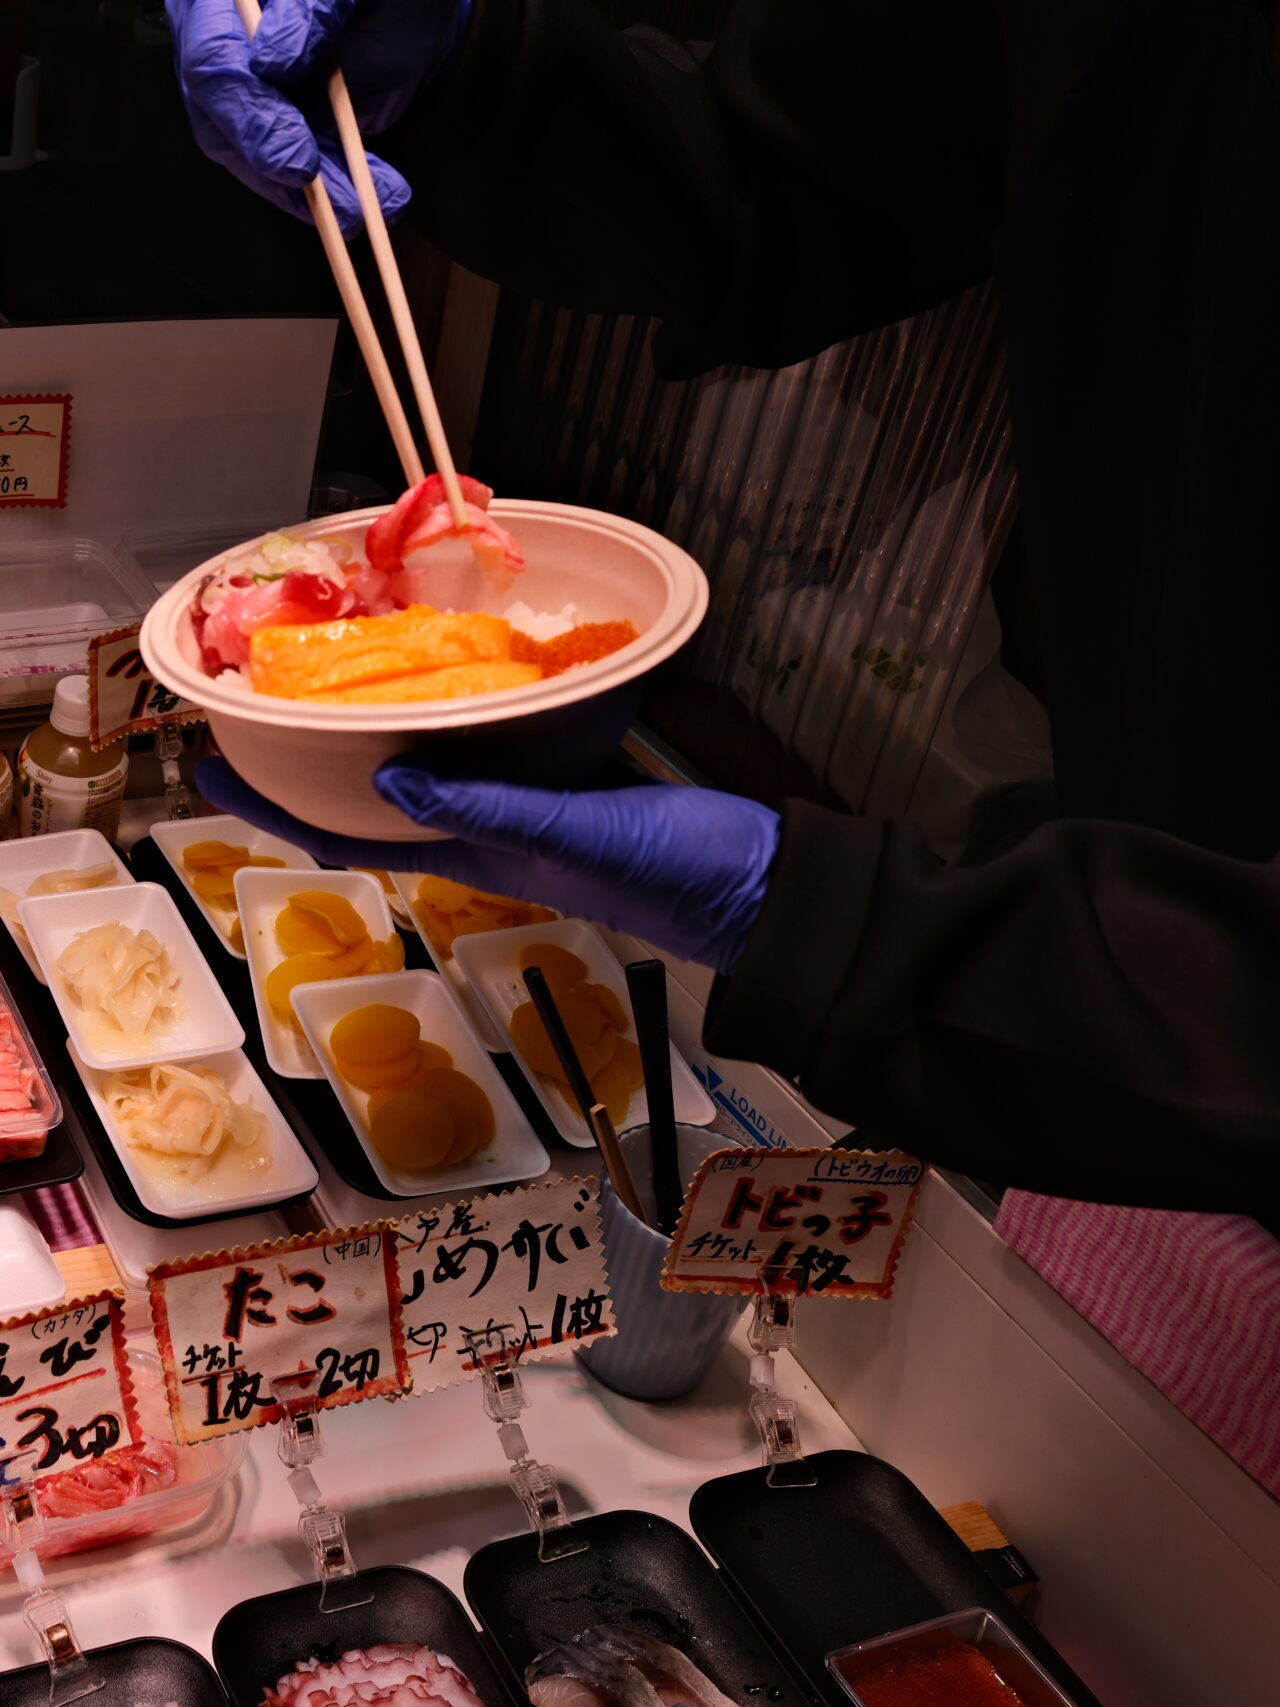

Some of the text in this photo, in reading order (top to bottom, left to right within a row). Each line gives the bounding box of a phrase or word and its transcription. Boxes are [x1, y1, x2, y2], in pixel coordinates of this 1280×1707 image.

[31, 782, 44, 836] 青森のお
[729, 1087, 767, 1132] LOAD
[812, 1157, 925, 1188] (トビウオの卵)
[722, 1177, 894, 1245] トビっ子
[322, 1233, 382, 1265] (中国)
[31, 1303, 97, 1340] (カナダ)
[222, 1267, 337, 1344] たこ
[181, 1342, 243, 1374] チケット
